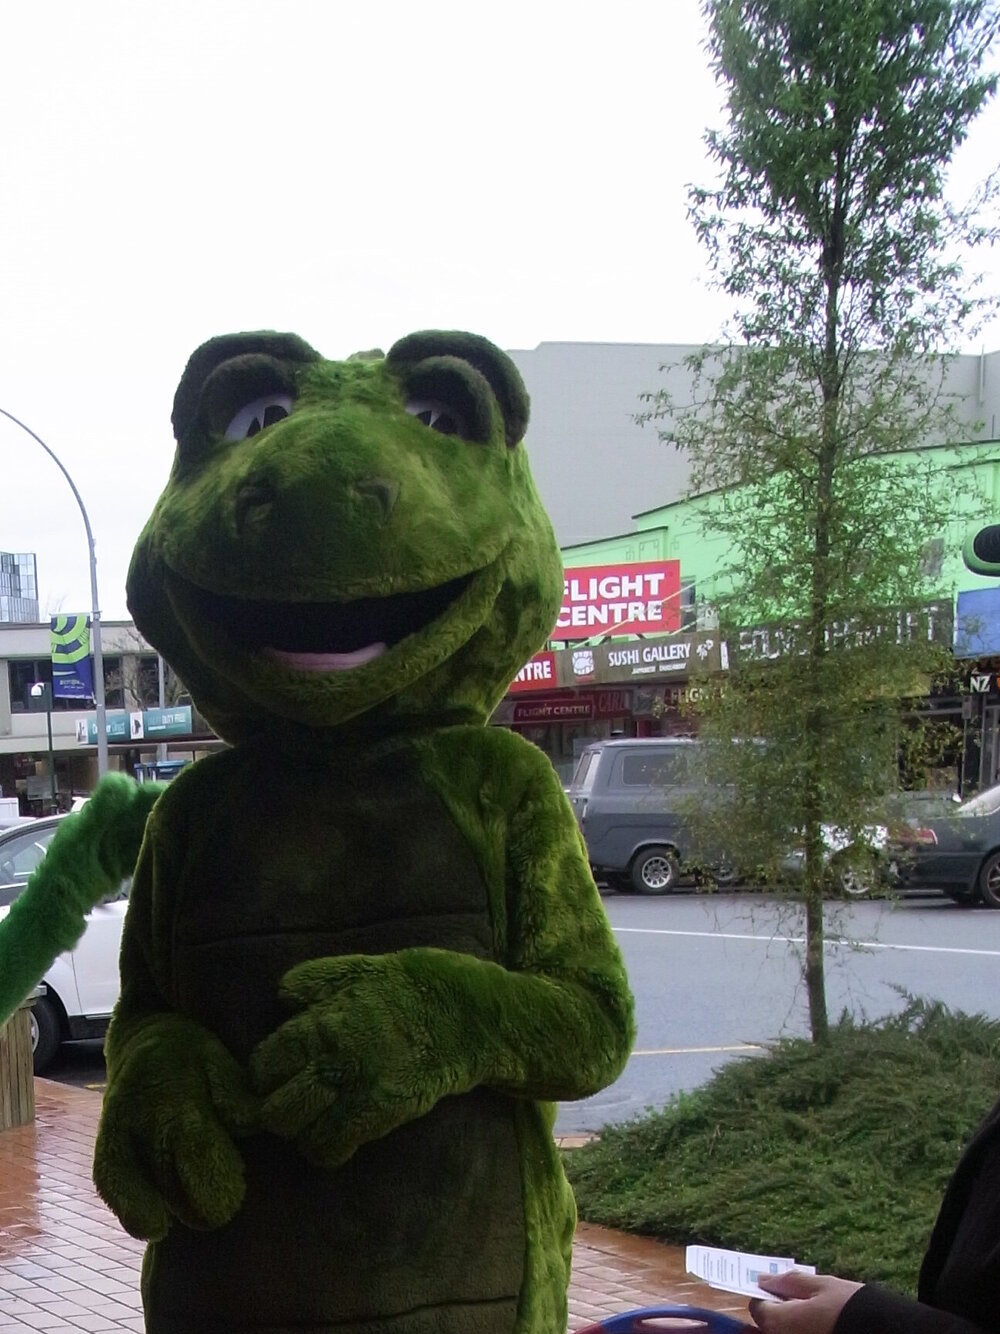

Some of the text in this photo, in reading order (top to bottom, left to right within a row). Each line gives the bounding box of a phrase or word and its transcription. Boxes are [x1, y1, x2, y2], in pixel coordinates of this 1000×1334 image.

[556, 600, 662, 627] CENTRE
[608, 648, 640, 667] SUSHI
[643, 643, 691, 663] GALLERY
[970, 675, 993, 693] NZ
[517, 704, 591, 718] FLIGHT CENTRE
